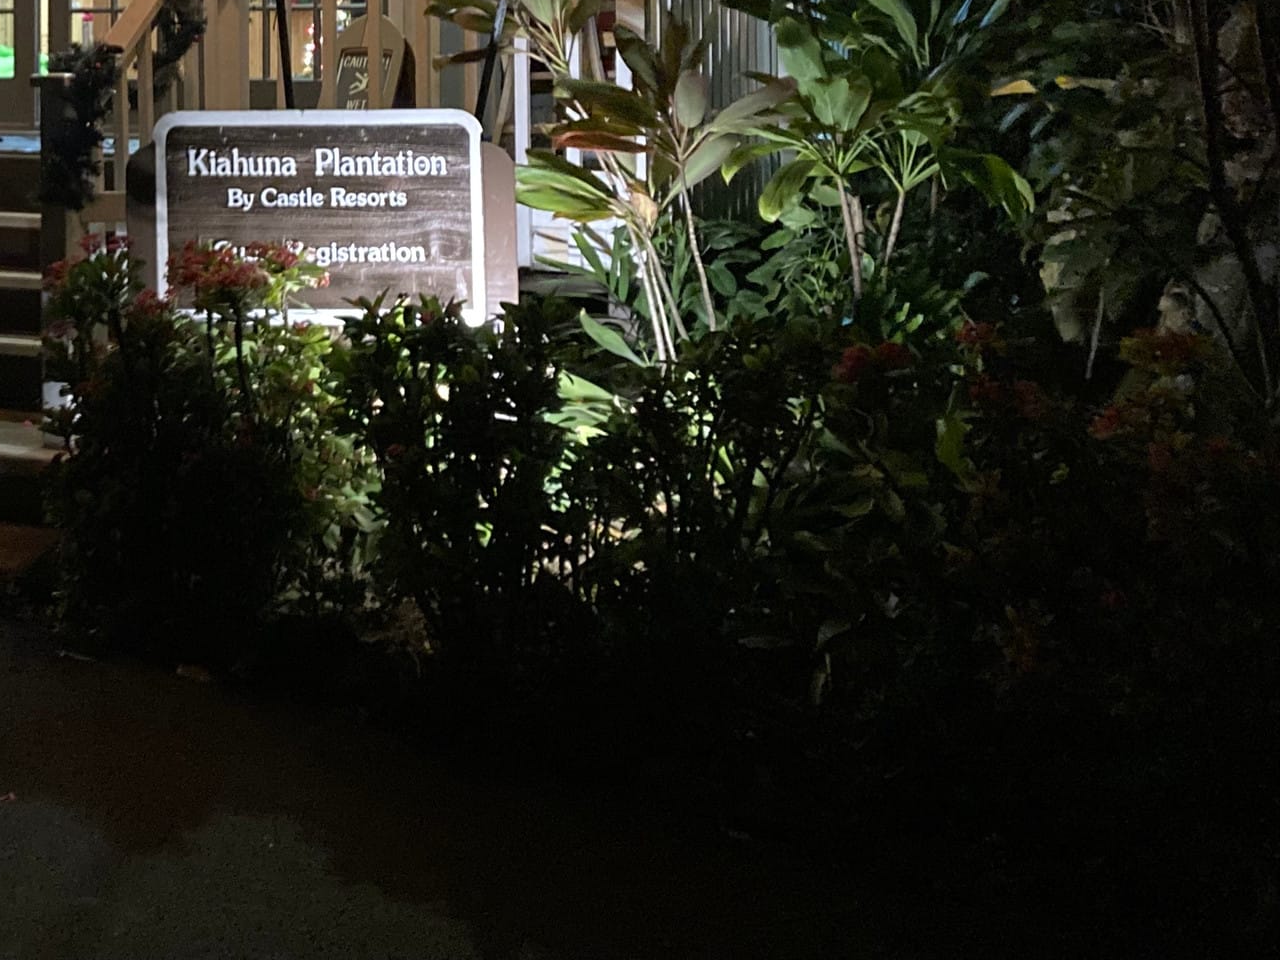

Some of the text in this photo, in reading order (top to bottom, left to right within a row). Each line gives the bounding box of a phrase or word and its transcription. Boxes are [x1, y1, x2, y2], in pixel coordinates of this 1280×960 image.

[187, 147, 448, 176] Kiahuna Plantation
[227, 186, 408, 212] By Castle Resorts
